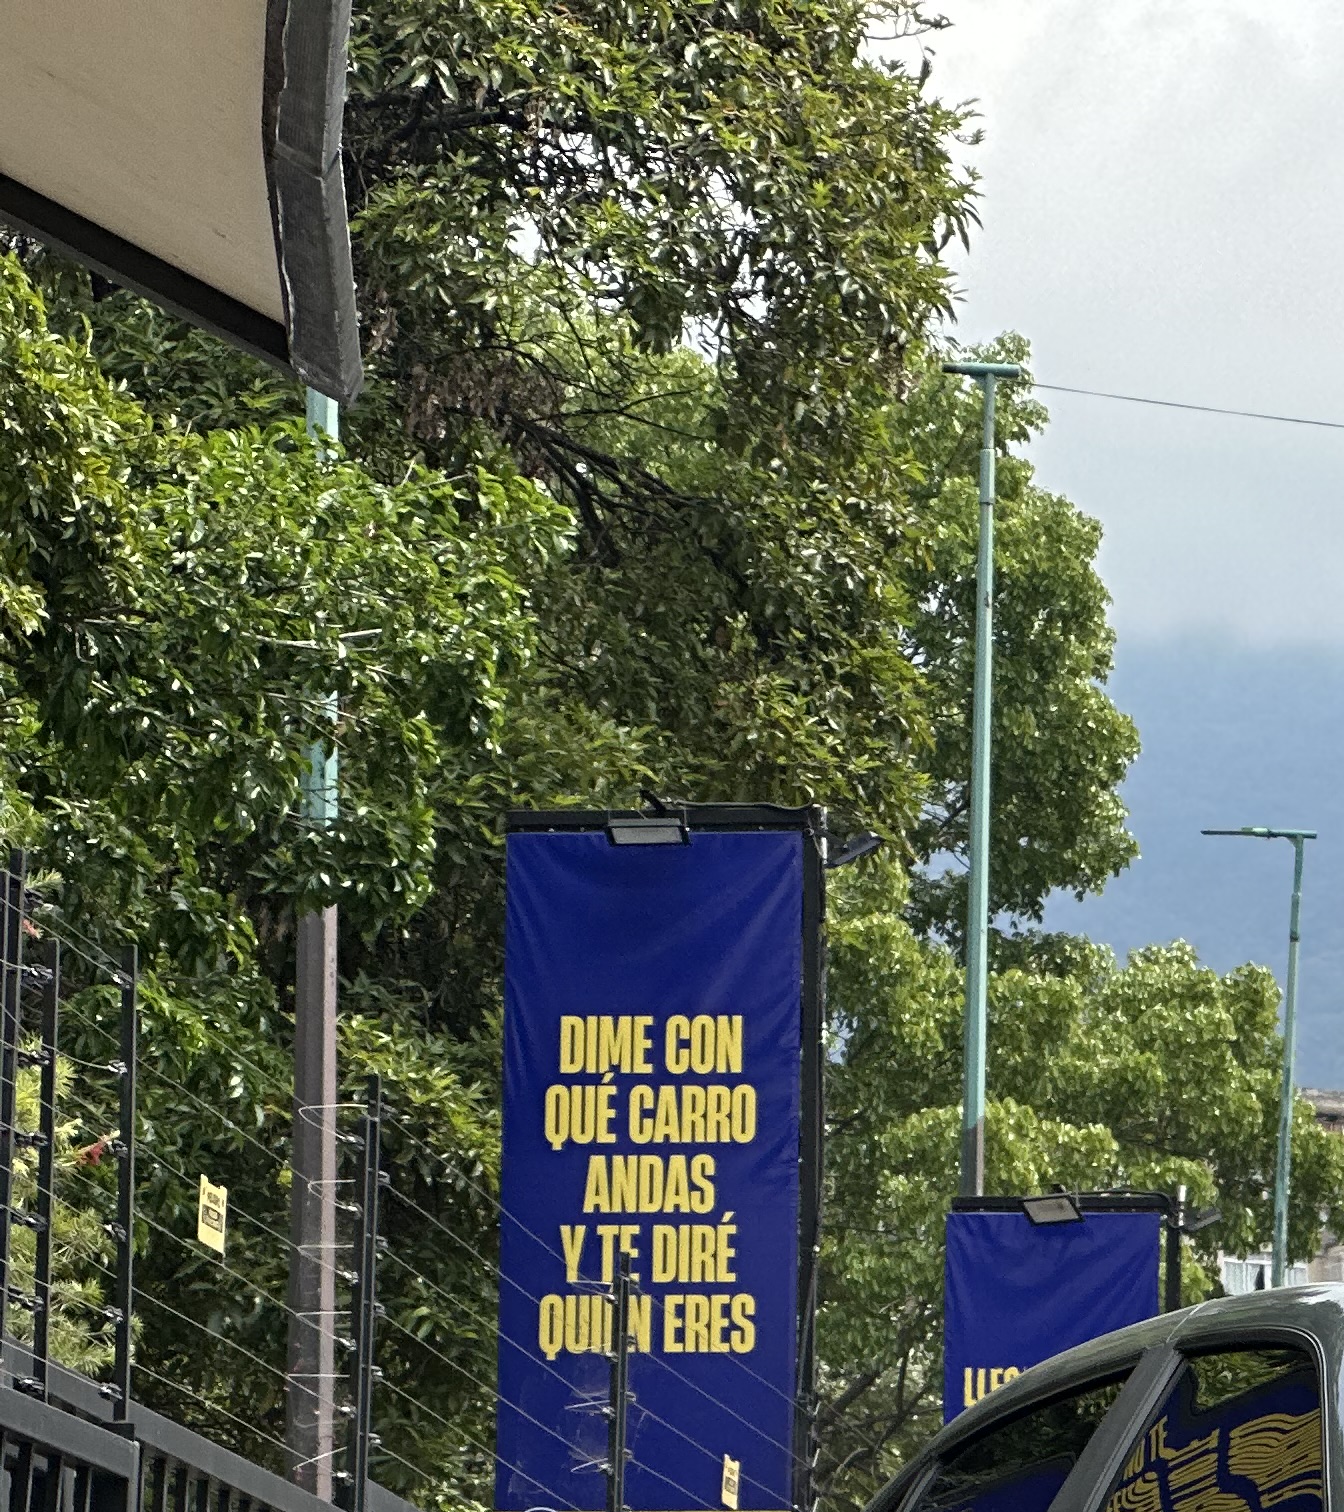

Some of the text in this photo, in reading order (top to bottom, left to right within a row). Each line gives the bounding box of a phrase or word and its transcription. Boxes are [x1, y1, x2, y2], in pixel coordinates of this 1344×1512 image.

[560, 1014, 743, 1075] DIME CON
[544, 1072, 757, 1151] QUÉ CARRO
[582, 1154, 716, 1214] ANDAS
[560, 1211, 737, 1283] Y TE DIRÉ
[664, 1293, 756, 1354] ERES
